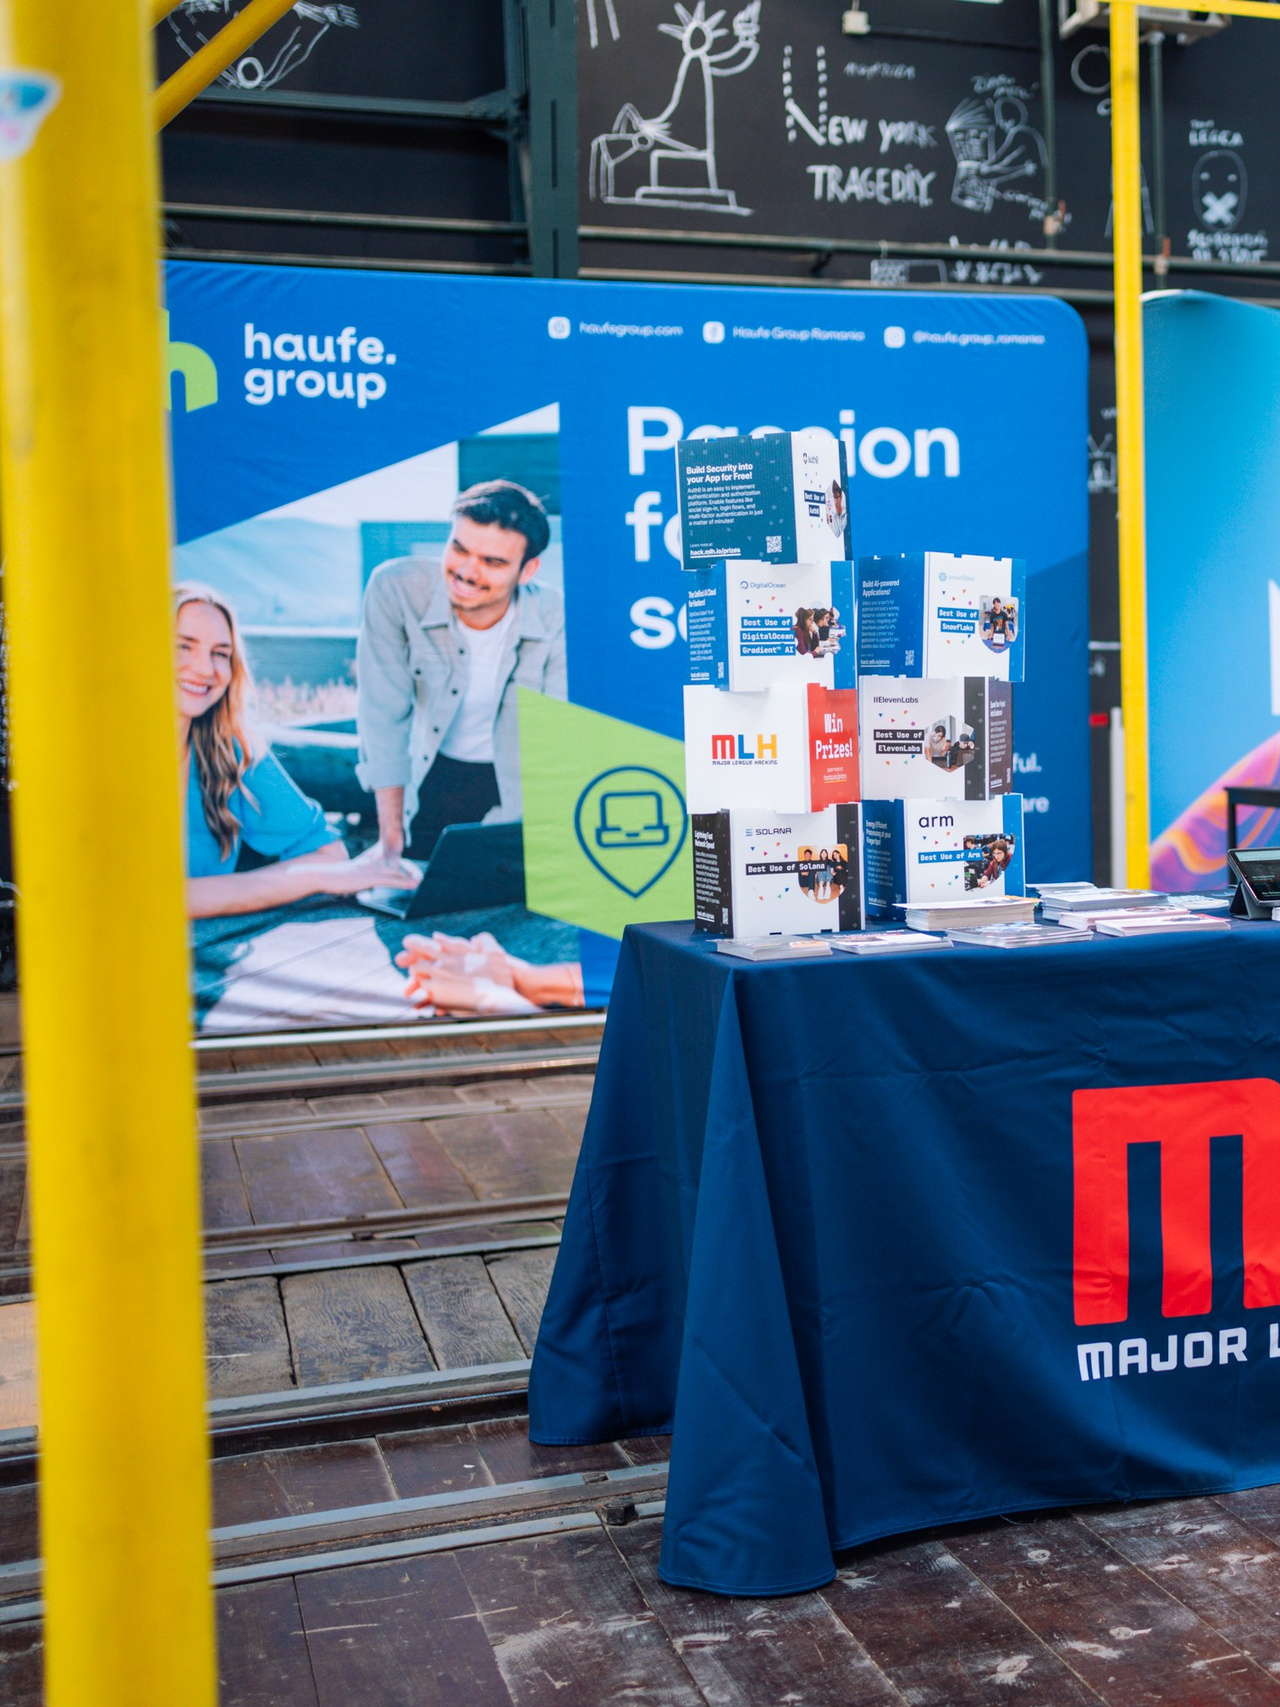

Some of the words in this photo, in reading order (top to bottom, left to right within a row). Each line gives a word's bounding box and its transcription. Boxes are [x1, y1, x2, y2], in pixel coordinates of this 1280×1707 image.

[579, 321, 684, 338] haufegroup.com
[732, 326, 771, 339] Haufe
[771, 327, 810, 341] Group
[810, 328, 866, 342] Romania
[244, 322, 398, 365] haufe.
[243, 367, 387, 409] group
[627, 406, 960, 478] Pion
[686, 465, 705, 475] Build
[706, 463, 737, 473] Security
[738, 462, 753, 471] into
[686, 476, 703, 485] your
[705, 474, 720, 484] App
[721, 473, 732, 481] for
[733, 471, 753, 480] Free!
[690, 547, 741, 556] hack.mlh.io/prizes
[750, 581, 787, 590] DigitalOcean
[939, 609, 953, 617] Best
[743, 618, 761, 626] Best
[764, 618, 778, 626] Use
[781, 618, 791, 626] of
[942, 623, 974, 632] Snowflake
[742, 632, 795, 641] DigitalOcean
[784, 646, 794, 654] AI
[824, 713, 843, 733] Win
[875, 730, 892, 739] Best
[896, 730, 910, 739] Use
[913, 730, 923, 739] of
[712, 734, 777, 760] MLH
[815, 738, 853, 760] Prizes!
[878, 744, 921, 753] ElevenLabs
[918, 814, 954, 828] arm
[755, 827, 792, 836] SOLANA
[920, 853, 938, 861] Best
[940, 852, 954, 860] Use
[956, 851, 965, 859] of
[967, 850, 981, 859] Arm
[748, 865, 766, 874] Best
[769, 864, 784, 872] Use
[786, 863, 796, 872] of
[799, 862, 825, 871] Solana
[1076, 1326, 1247, 1382] MAJOR
